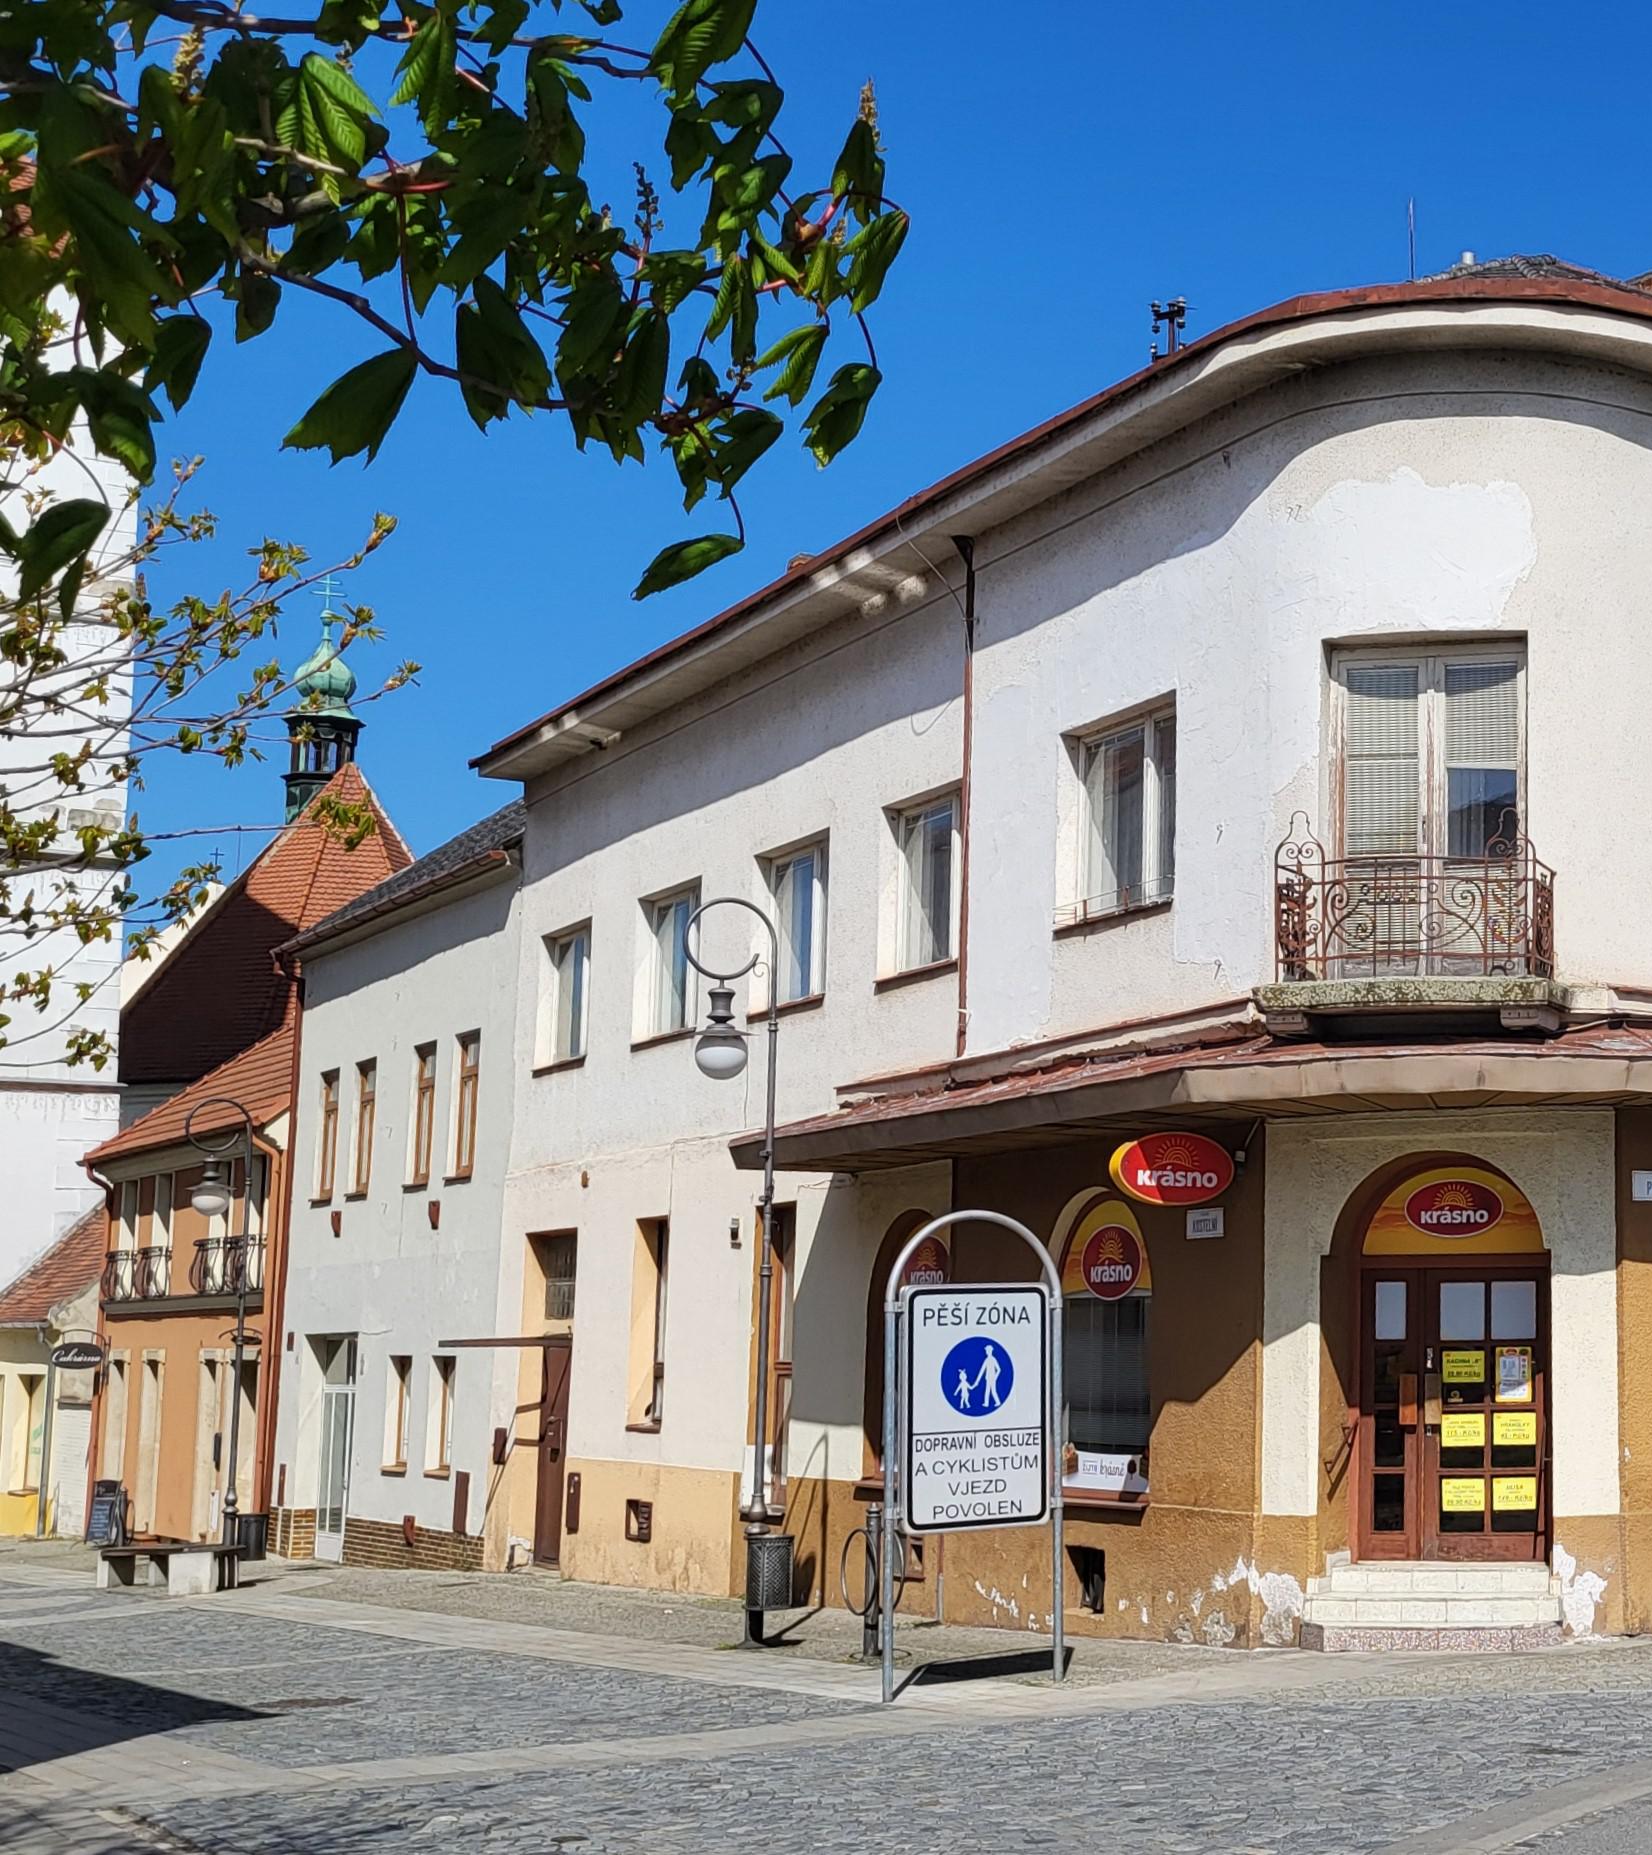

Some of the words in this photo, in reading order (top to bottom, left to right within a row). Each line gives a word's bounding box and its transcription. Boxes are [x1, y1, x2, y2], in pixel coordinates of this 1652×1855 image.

[923, 1302, 970, 1327] PĚŠÍ
[976, 1302, 1031, 1326] ZÓNA
[915, 1432, 977, 1453] DOPRAVNÍ
[984, 1432, 1040, 1449] OBSLUZE
[914, 1461, 928, 1477] A
[932, 1452, 1039, 1476] CYKLISTŮM
[947, 1479, 1007, 1497] VJEZD
[932, 1499, 1023, 1521] POVOLEN
